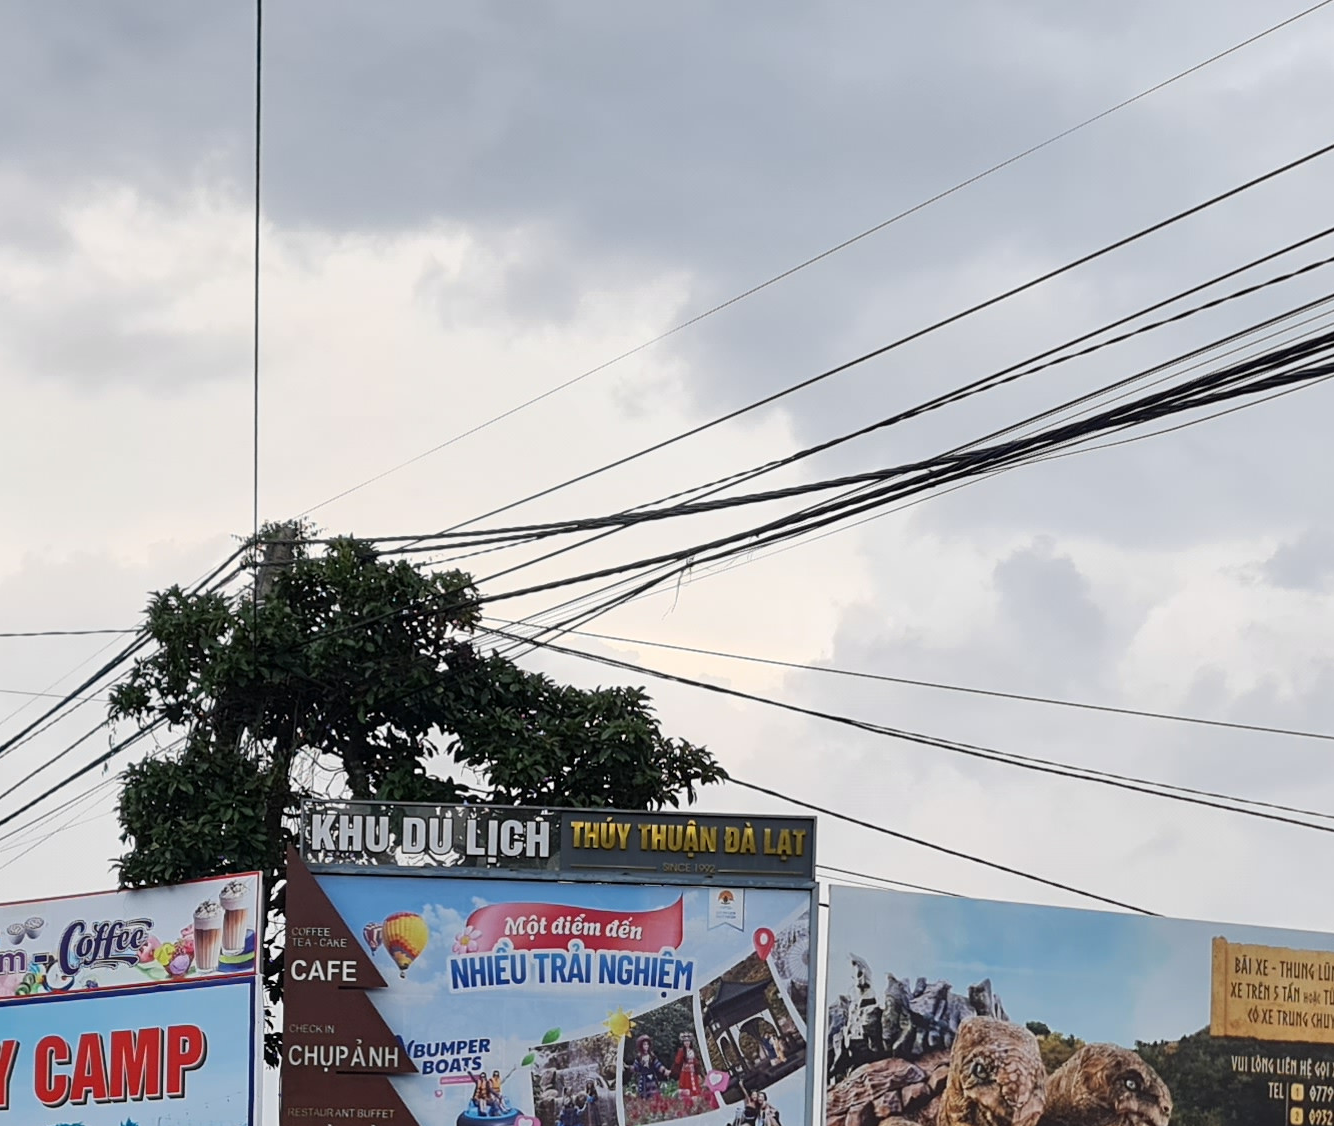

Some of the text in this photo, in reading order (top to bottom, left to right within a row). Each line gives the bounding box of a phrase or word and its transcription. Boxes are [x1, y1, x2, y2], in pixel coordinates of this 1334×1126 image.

[312, 814, 551, 864] KHU DU LỊCH
[570, 816, 807, 861] THÚY THUẬN ĐÀ LẠT
[663, 862, 716, 873] SINCE 1992
[291, 926, 331, 937] COFFEE
[504, 914, 643, 941] Một điểm đến
[58, 919, 154, 976] Coffee
[291, 937, 348, 948] TEA CAKE
[290, 959, 357, 982] CAFE
[450, 940, 694, 998] NHIỀU TRẢI NGHIỆM
[1234, 954, 1251, 975] BÃI
[1255, 958, 1269, 977] XE
[1279, 960, 1315, 980] THUNG
[1230, 981, 1243, 998] XE
[1246, 981, 1270, 1000] TRÊN
[1273, 985, 1279, 1001] 5
[1282, 981, 1300, 1003] TẤN
[1247, 1004, 1260, 1024] CÓ
[1261, 1008, 1274, 1025] XE
[1276, 1009, 1308, 1028] TRUNG
[288, 1023, 335, 1034] CHECK IN
[33, 1023, 208, 1108] CAMP
[422, 1056, 482, 1075] BOATS
[1231, 1055, 1248, 1072] VUI
[1250, 1054, 1274, 1074] LÒNG
[1276, 1056, 1297, 1076] LIÊN
[1299, 1057, 1313, 1080] HỆ
[1314, 1060, 1330, 1080] GỌI
[1268, 1082, 1285, 1099] TEL
[1309, 1085, 1334, 1103] 0779
[287, 1107, 396, 1119] RESTAURANT BUFFET
[1308, 1108, 1333, 1126] 0932
